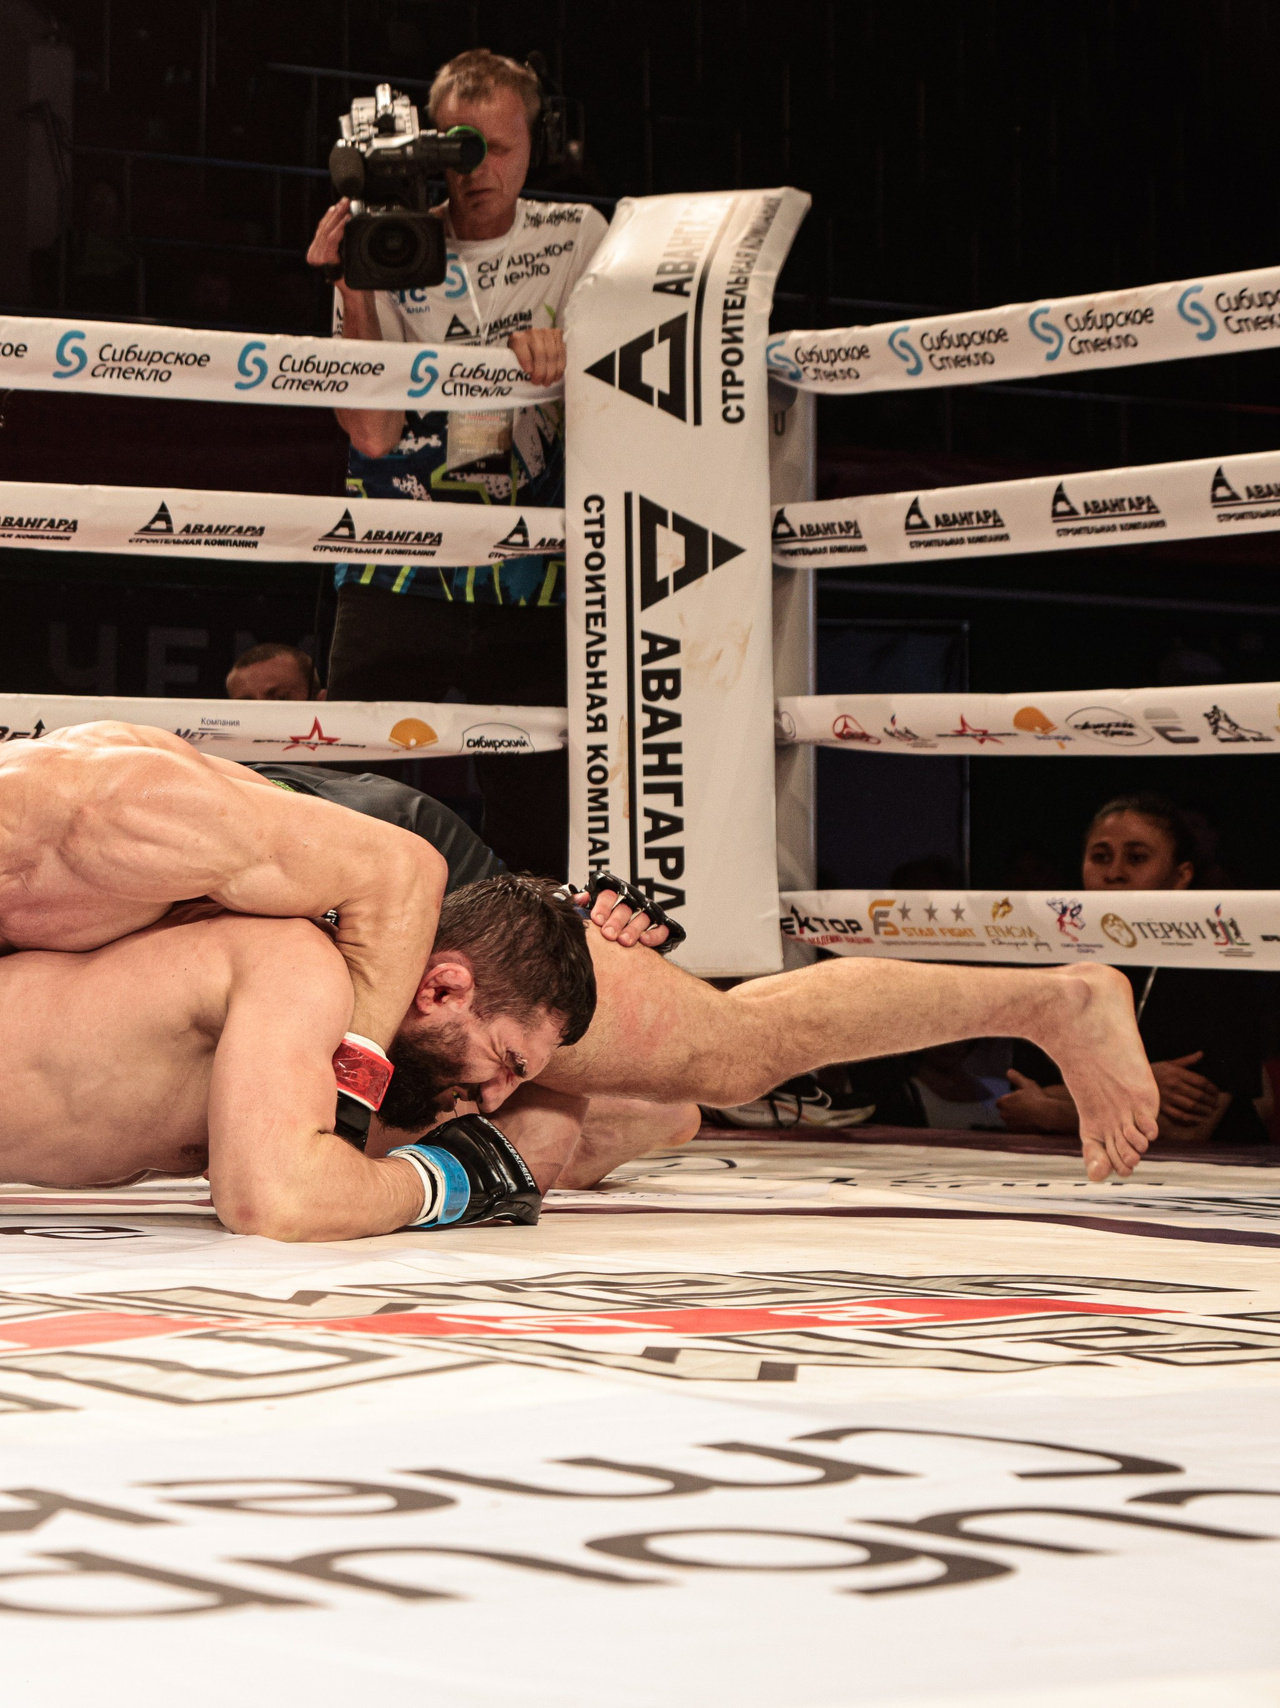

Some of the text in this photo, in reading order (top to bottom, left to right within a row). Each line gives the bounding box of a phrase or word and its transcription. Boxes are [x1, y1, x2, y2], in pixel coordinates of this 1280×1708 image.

[1064, 306, 1155, 335] Сибирское
[921, 327, 1009, 354] Сибирское
[1069, 333, 1138, 356] Стекло
[98, 344, 210, 369] Сибирское
[278, 355, 385, 378] Сибирское
[928, 351, 995, 372] Стекло
[91, 362, 172, 383] Стекло
[449, 362, 532, 384] Сибирск
[271, 374, 348, 394] Стекло
[441, 380, 512, 397] Стекло
[1083, 495, 1160, 514] АВАНГАРД
[180, 522, 265, 537] АВАНГАРД
[800, 520, 862, 538] АВАНГАРД
[934, 510, 1005, 529] АВАНГАРД
[362, 530, 442, 546] АВАНГАРД
[583, 494, 611, 878] СТРОИТЕЛЬНАЯ КОМПАН
[201, 717, 240, 727] Компания
[466, 736, 529, 751] сибирский
